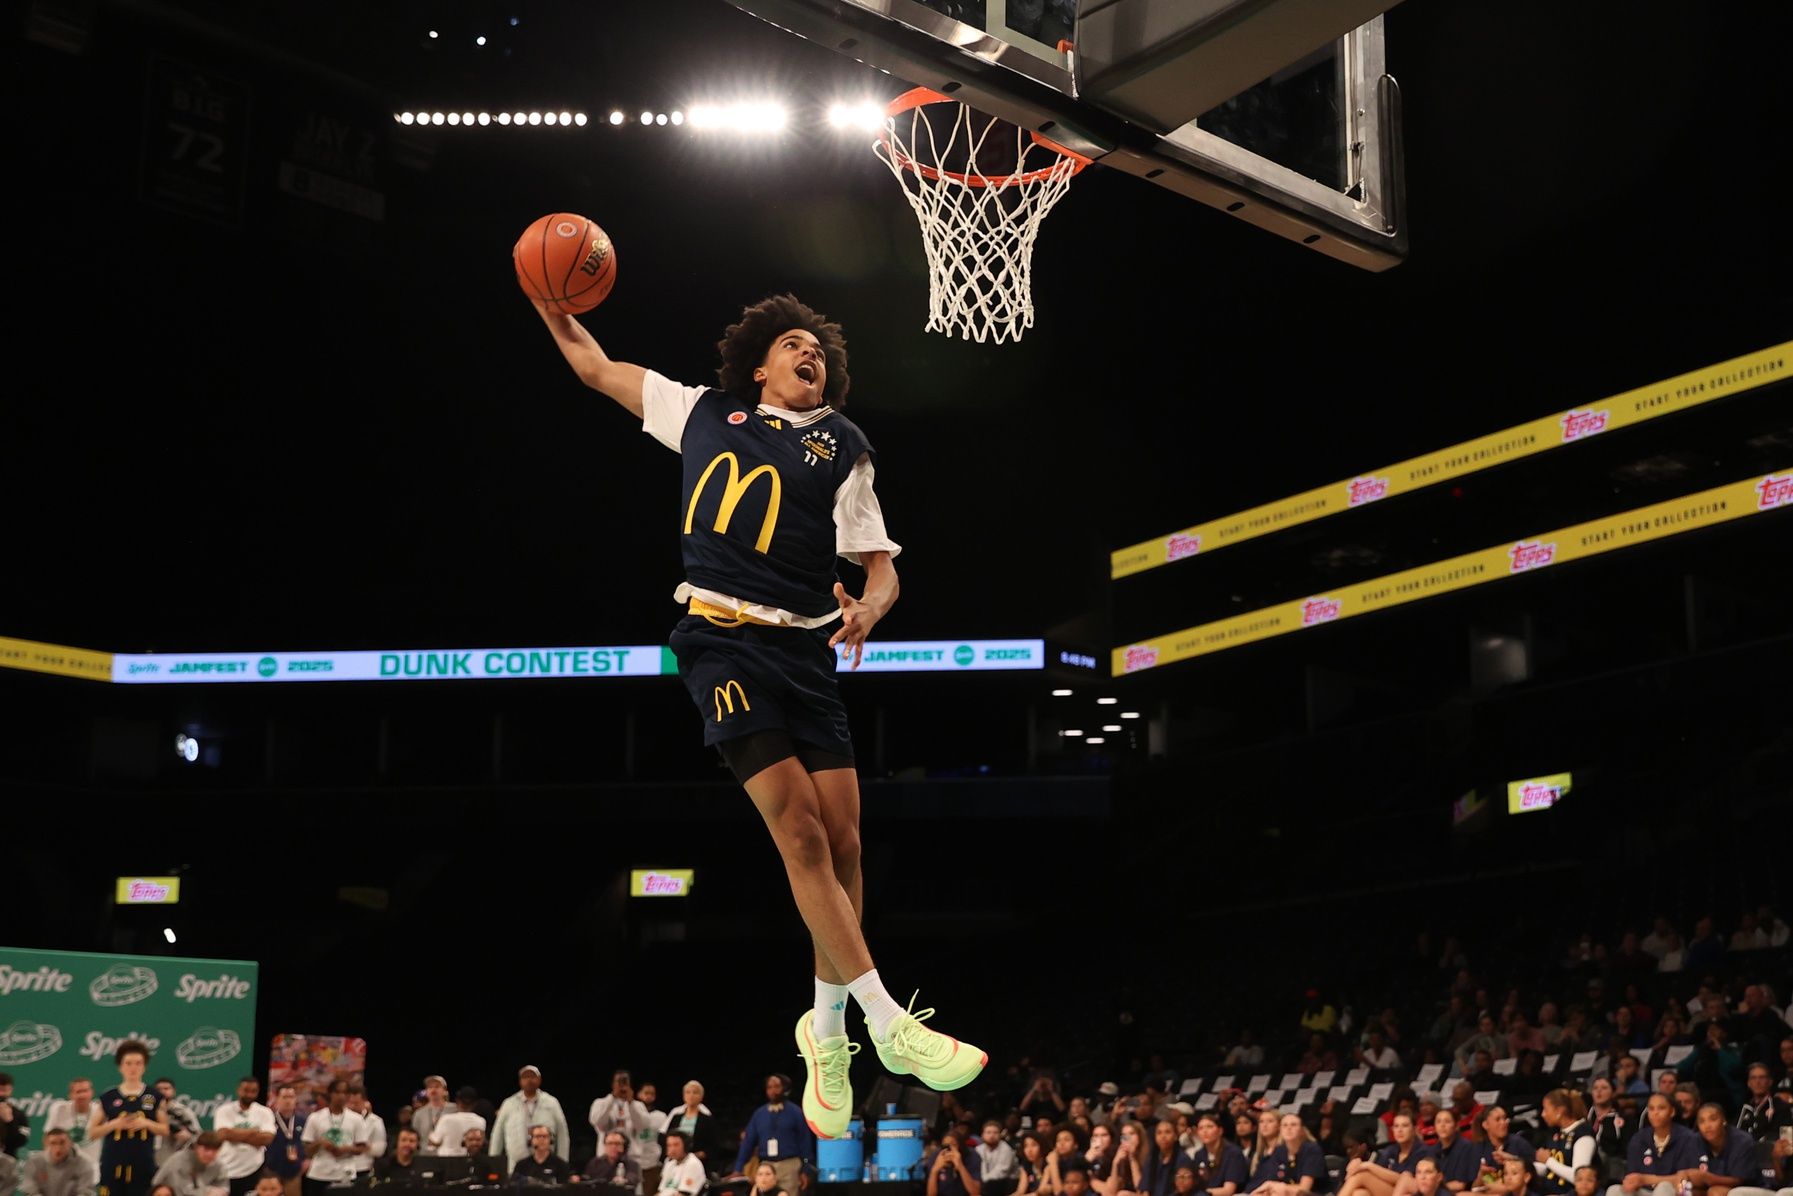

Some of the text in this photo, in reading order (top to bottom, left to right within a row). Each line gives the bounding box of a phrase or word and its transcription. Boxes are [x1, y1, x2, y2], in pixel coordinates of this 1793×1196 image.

[167, 121, 224, 173] 72
[1709, 359, 1784, 389] COLLECTION
[168, 660, 249, 674] JAMFEST
[287, 659, 334, 672] 2025
[380, 650, 631, 676] DUNK CONTEST
[863, 649, 944, 662] JAMFEST
[984, 647, 1031, 661] 2025
[0, 964, 72, 995] Sprite
[174, 973, 251, 1003] Sprite
